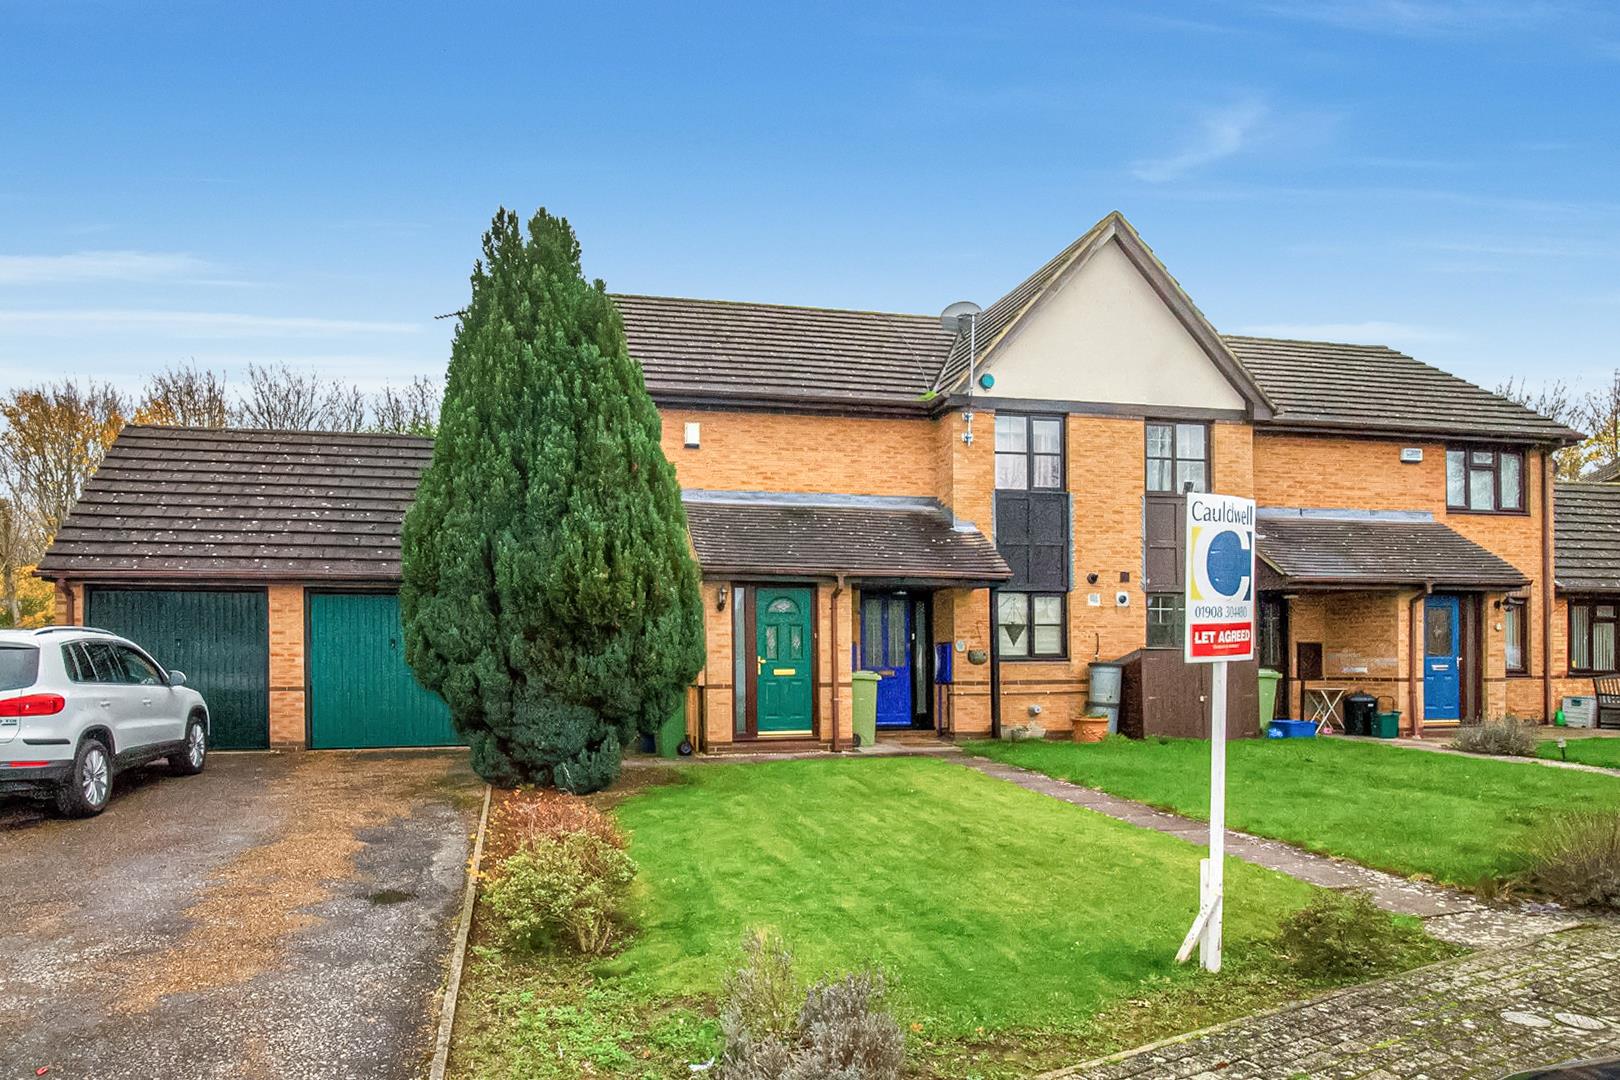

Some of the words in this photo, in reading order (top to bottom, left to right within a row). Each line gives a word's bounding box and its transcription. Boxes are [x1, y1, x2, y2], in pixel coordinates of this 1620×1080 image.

[1191, 500, 1253, 526] Cauldwell
[1193, 527, 1250, 600] C
[1194, 605, 1223, 618] 01908
[1194, 630, 1216, 644] LET
[1218, 628, 1251, 643] AGREED
